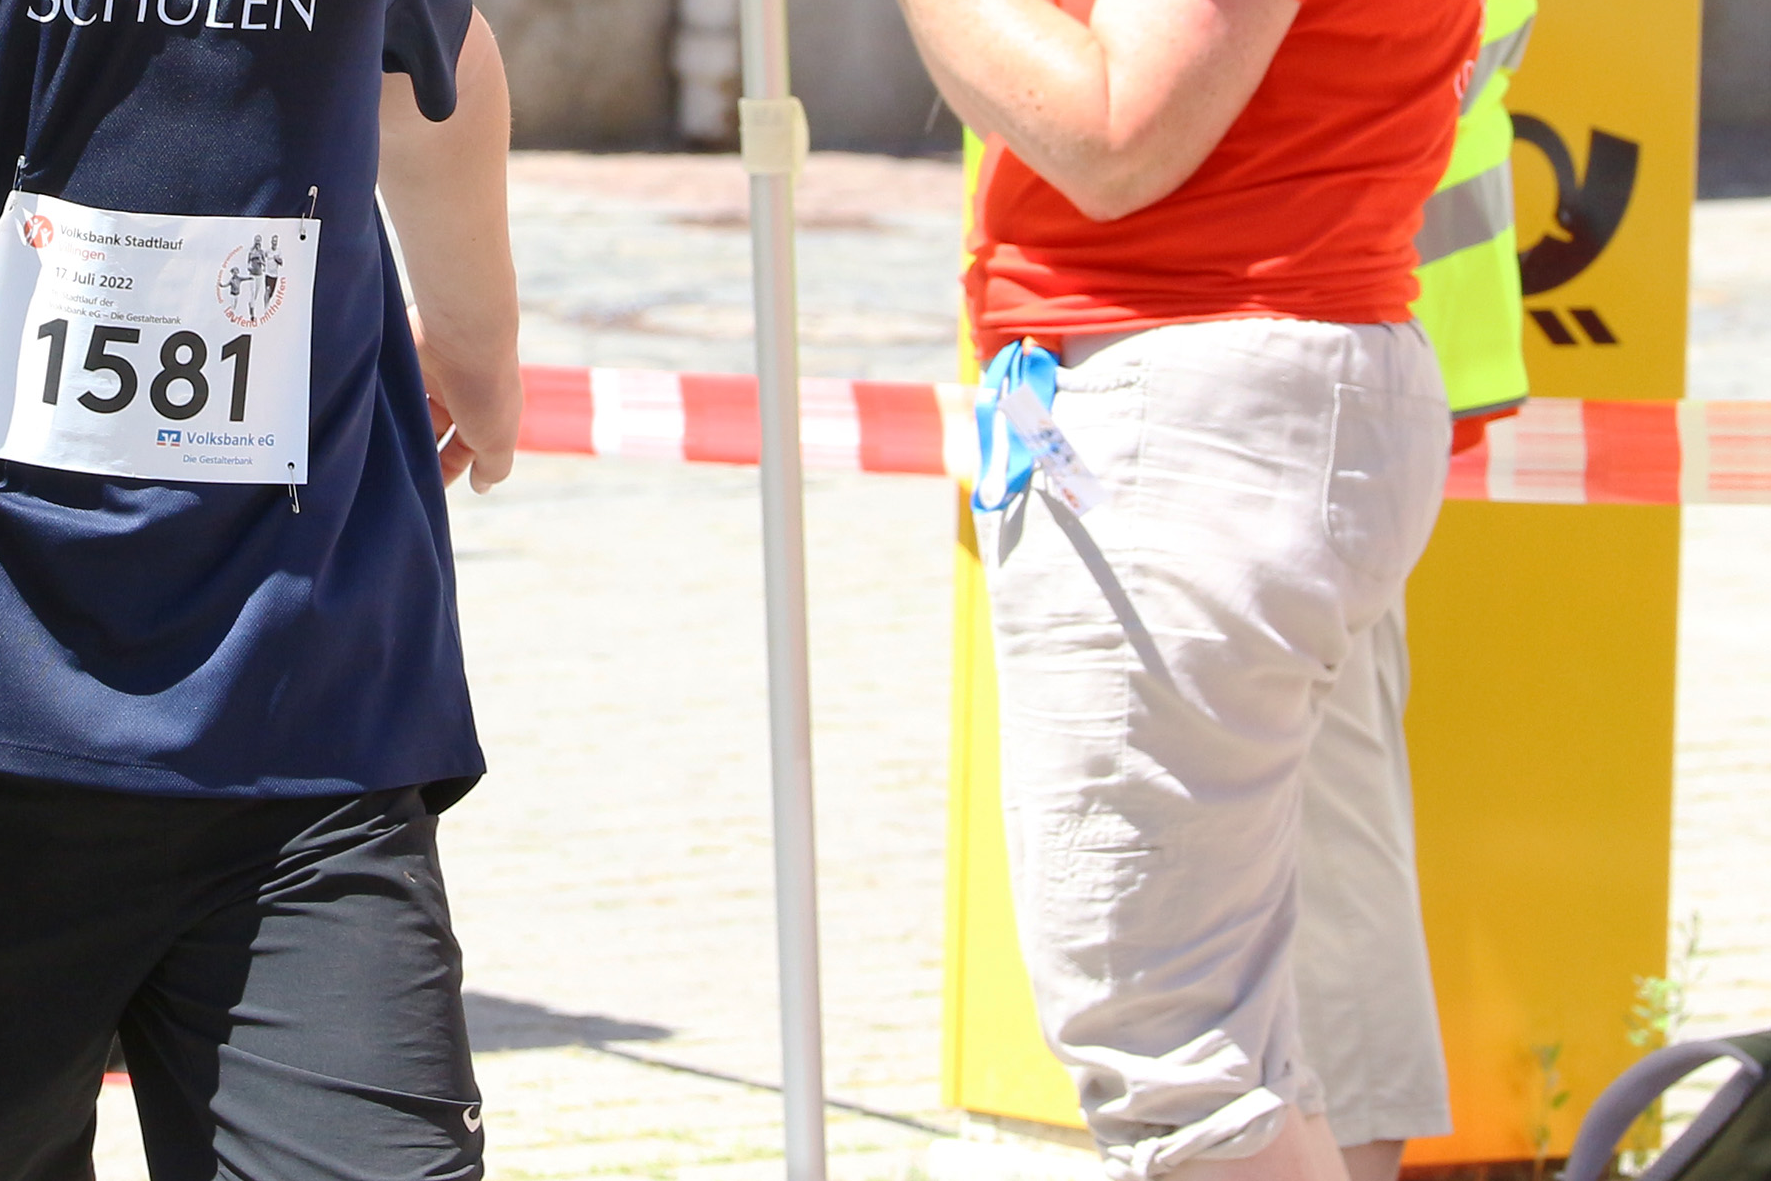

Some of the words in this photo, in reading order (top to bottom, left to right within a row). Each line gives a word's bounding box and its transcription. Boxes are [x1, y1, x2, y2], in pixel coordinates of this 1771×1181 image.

[60, 225, 121, 246] Volksbank
[125, 235, 183, 250] Stadtlauf
[73, 272, 95, 286] Juli
[99, 275, 133, 290] 2022
[100, 298, 114, 307] der
[111, 312, 125, 320] Die
[126, 313, 181, 325] Gestalterbank
[37, 318, 252, 422] 1581
[186, 431, 255, 447] Volksbank
[257, 433, 275, 447] eG
[183, 454, 197, 464] Die
[199, 455, 253, 466] Gestalterbank
